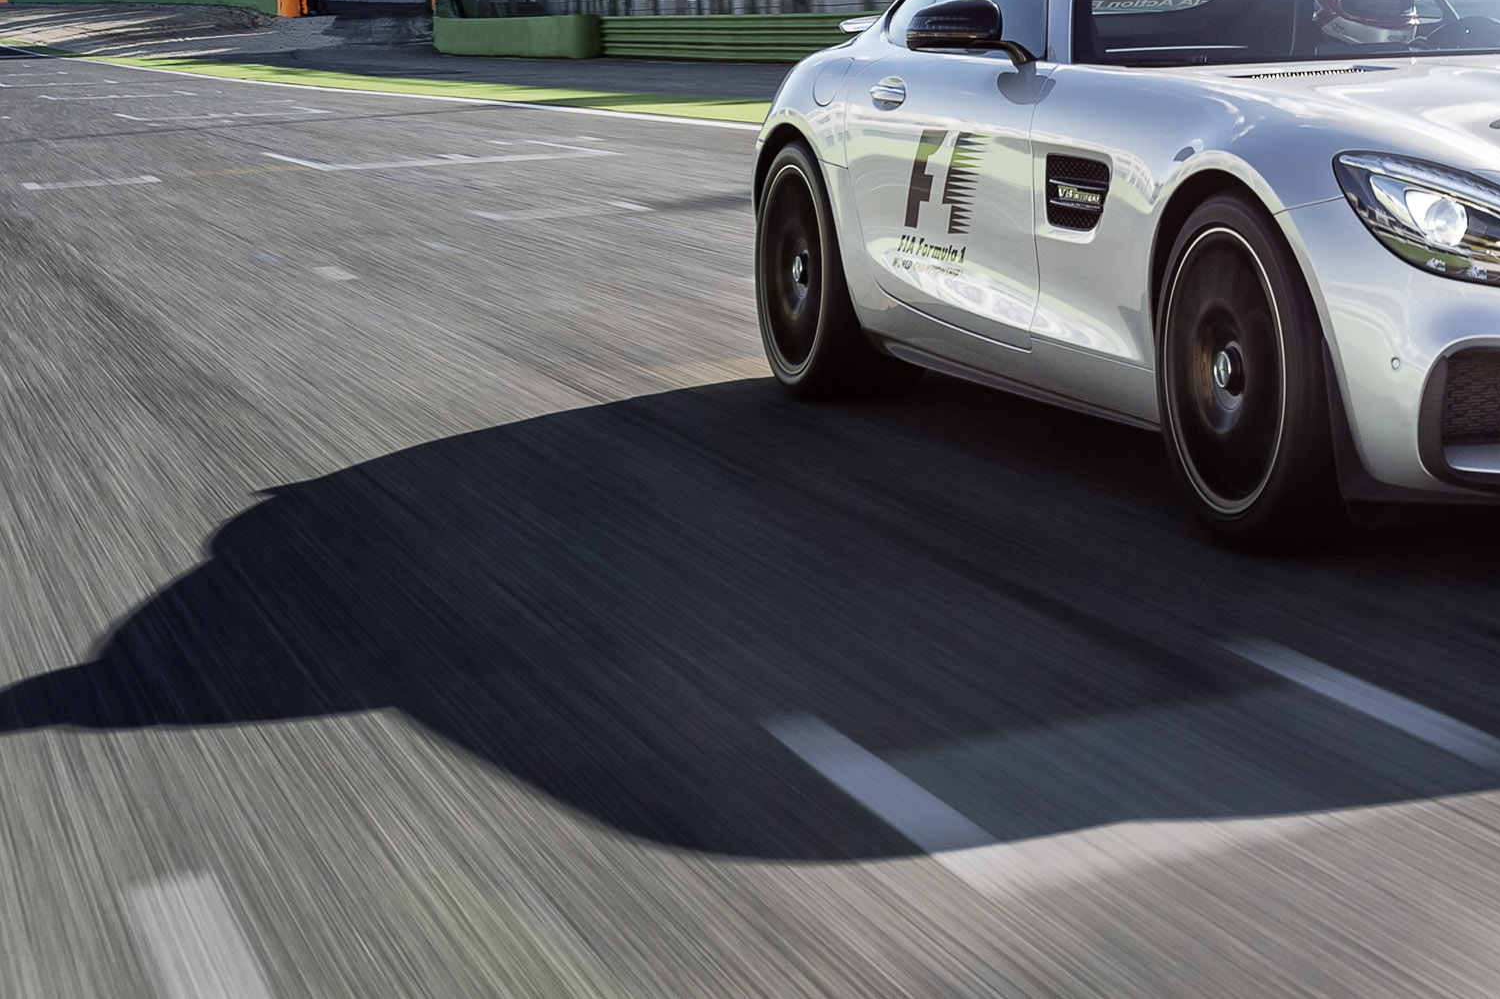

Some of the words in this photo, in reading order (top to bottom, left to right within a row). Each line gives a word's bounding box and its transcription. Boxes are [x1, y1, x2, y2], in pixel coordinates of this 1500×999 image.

[897, 234, 916, 255] FIA
[915, 238, 958, 262] Formula
[958, 246, 967, 264] 1
